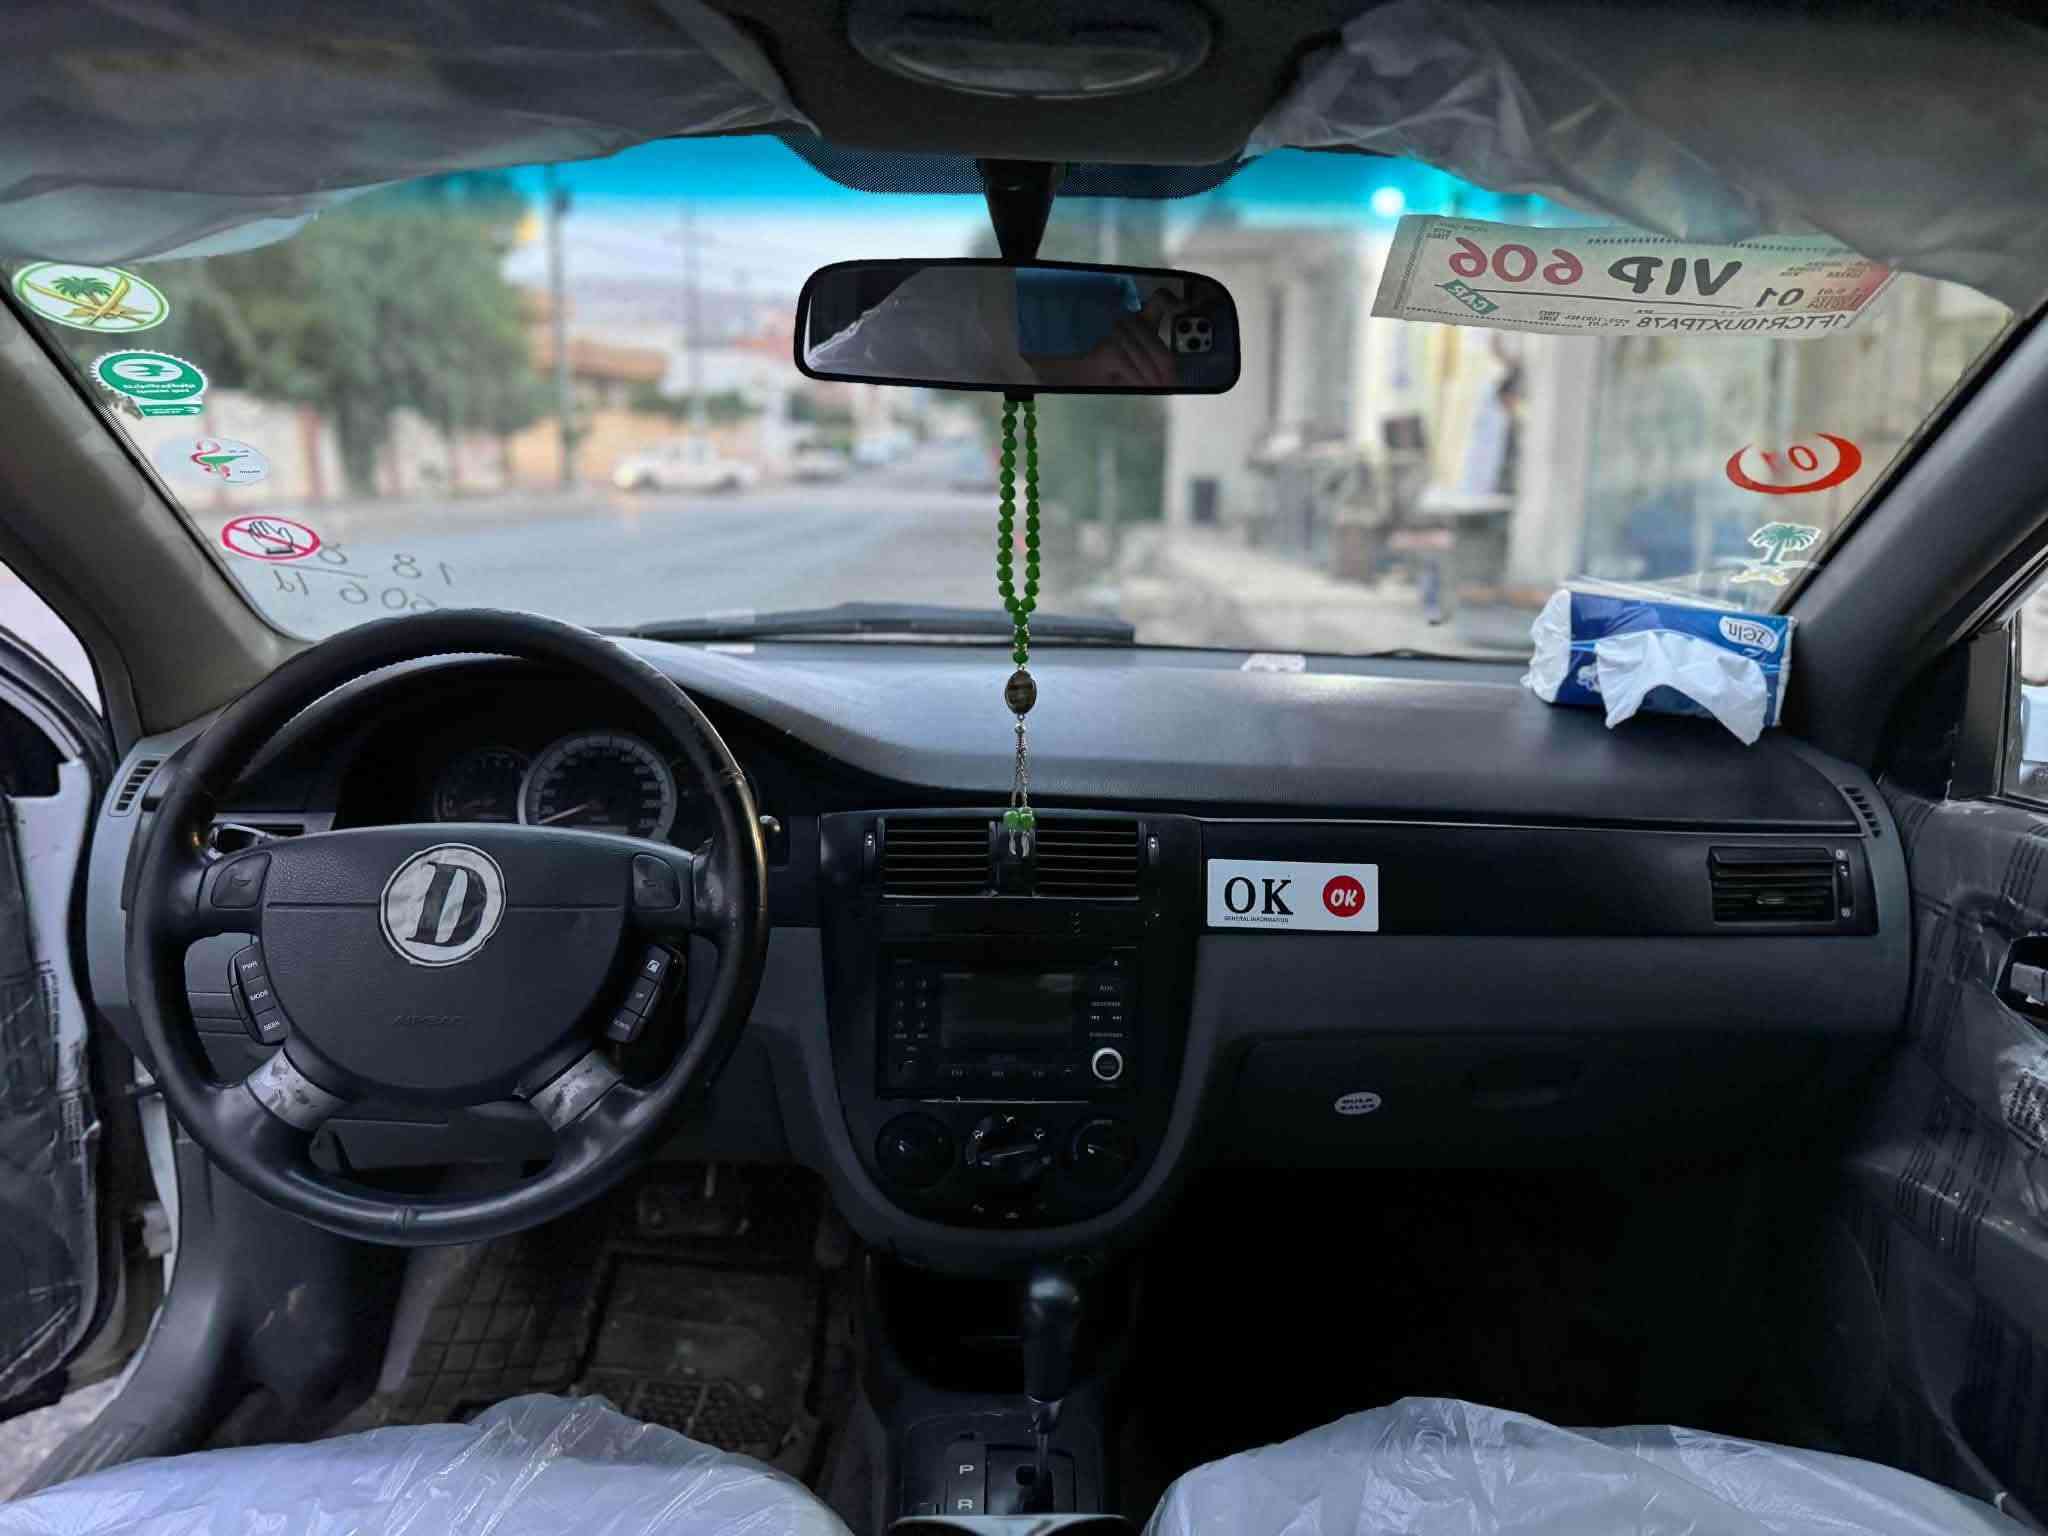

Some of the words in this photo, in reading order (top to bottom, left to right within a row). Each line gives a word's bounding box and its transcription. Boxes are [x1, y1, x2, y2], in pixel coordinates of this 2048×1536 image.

[1224, 876, 1294, 915] OK
[1330, 888, 1358, 908] OK
[959, 1464, 975, 1475] P
[957, 1498, 974, 1510] R
